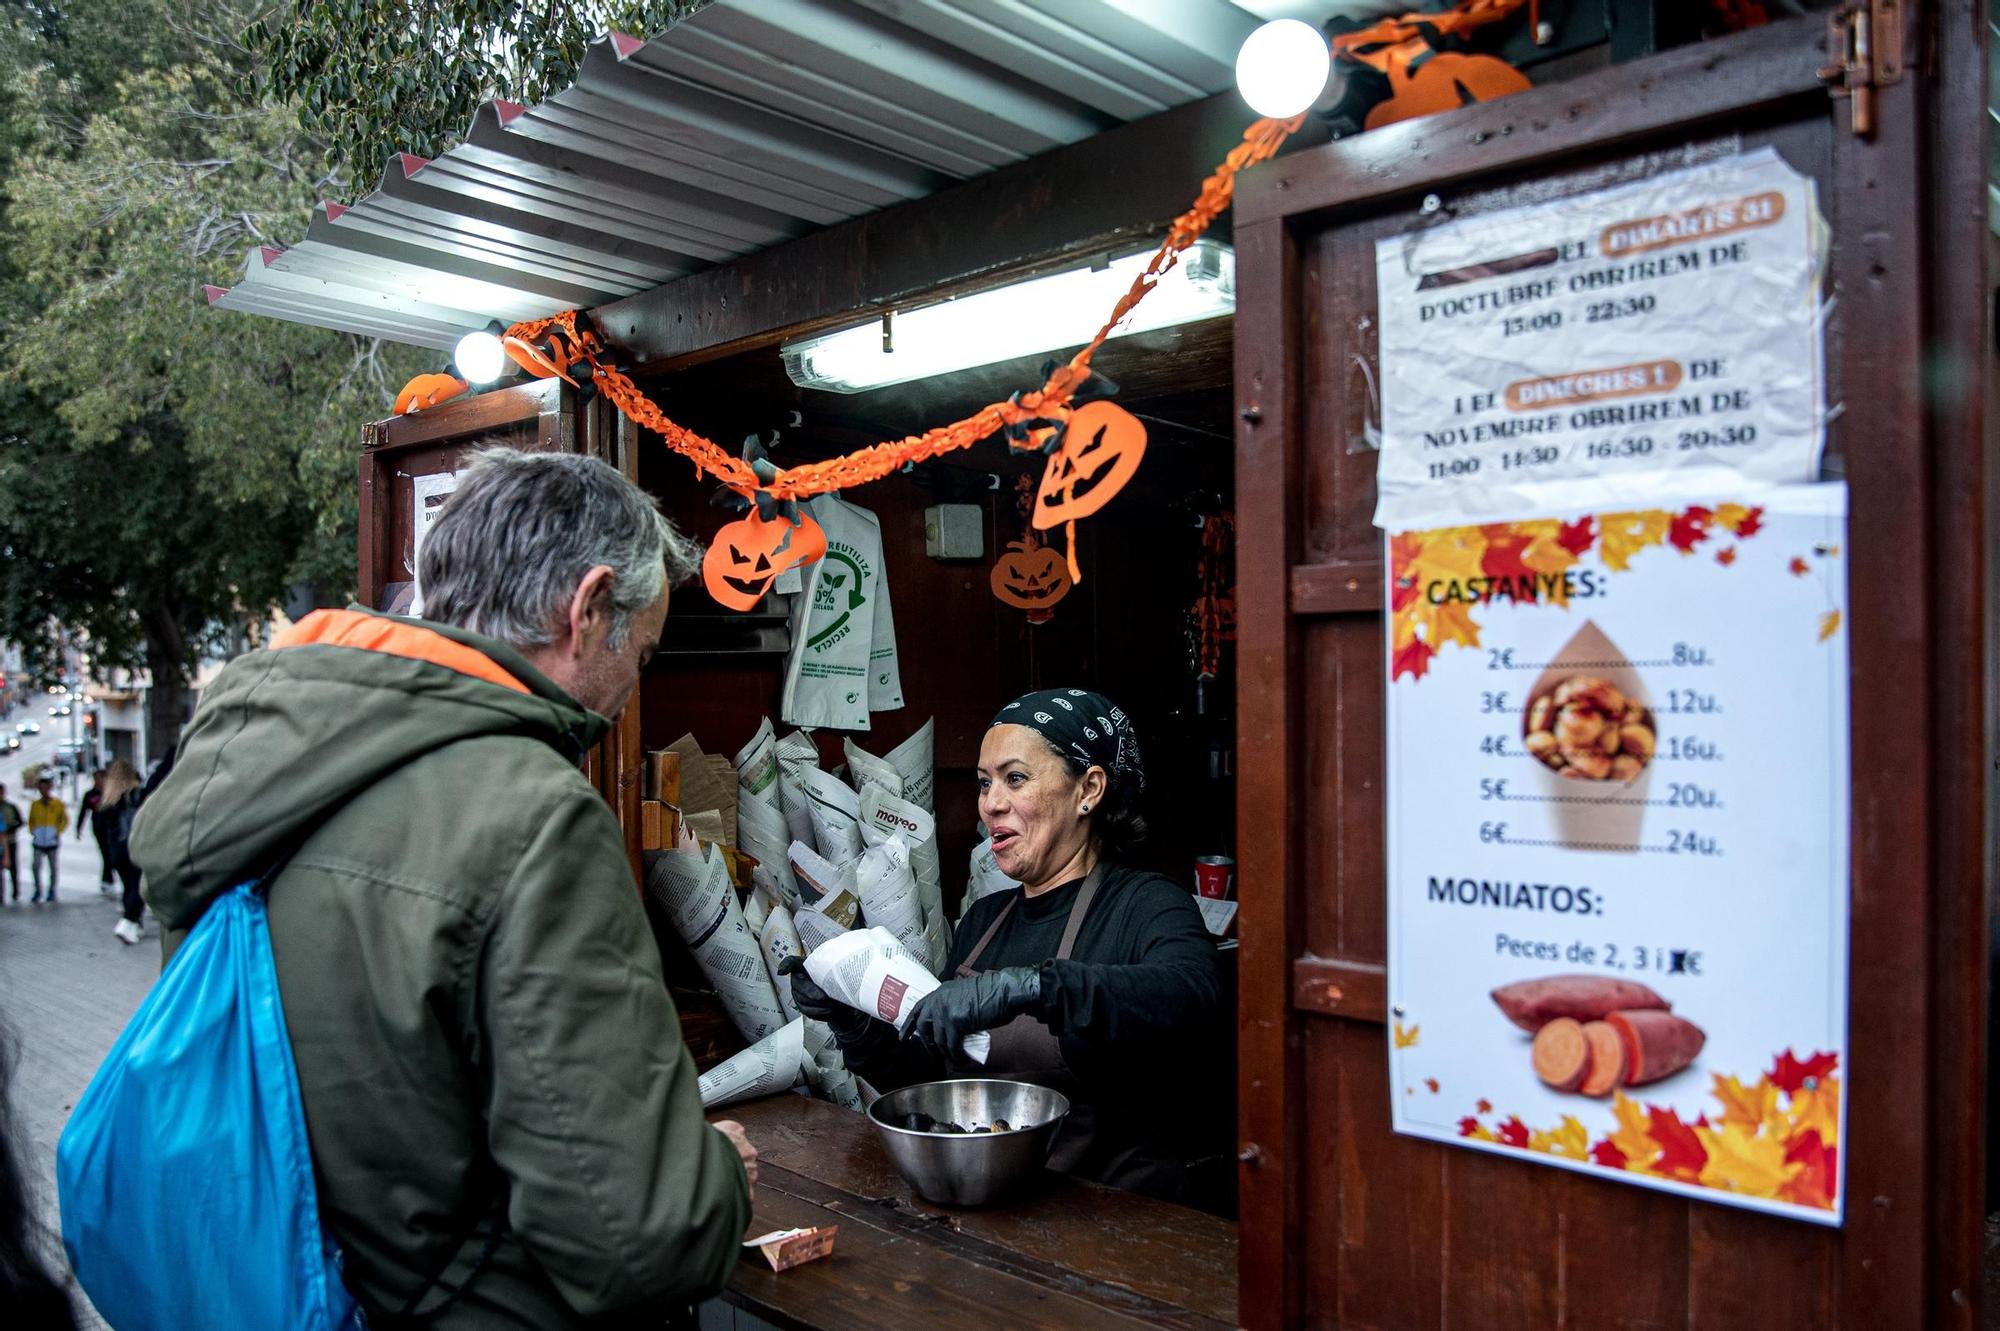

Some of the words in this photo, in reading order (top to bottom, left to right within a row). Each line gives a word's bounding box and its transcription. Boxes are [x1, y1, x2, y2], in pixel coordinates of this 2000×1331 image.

[1608, 206, 1737, 251] DIMARTS
[1741, 198, 1773, 223] 31
[1419, 277, 1558, 323] D'OCTUBRE
[1568, 250, 1701, 292] OBRIREM
[1710, 240, 1748, 267] DE
[1586, 295, 1656, 323] 22:30
[1471, 391, 1497, 412] EL
[1689, 359, 1727, 381] DE
[1424, 413, 1561, 449] NOVEMBRE
[1570, 398, 1702, 430] OBRIREM
[1711, 389, 1751, 413] DE
[1428, 457, 1481, 479] 11:00
[1588, 436, 1653, 459] 16:30
[1678, 424, 1757, 451] 20:30
[828, 541, 872, 578] REUTILIZA
[1426, 570, 1607, 605] CASTANYES:
[814, 625, 850, 653] RECICLA
[875, 809, 918, 832] moveo
[1428, 877, 1603, 917] MONIATOS:
[1495, 932, 1560, 961] Peces
[1566, 940, 1597, 964] de
[1604, 943, 1626, 970] 2,
[1633, 946, 1648, 970] 3
[1655, 948, 1663, 972] i
